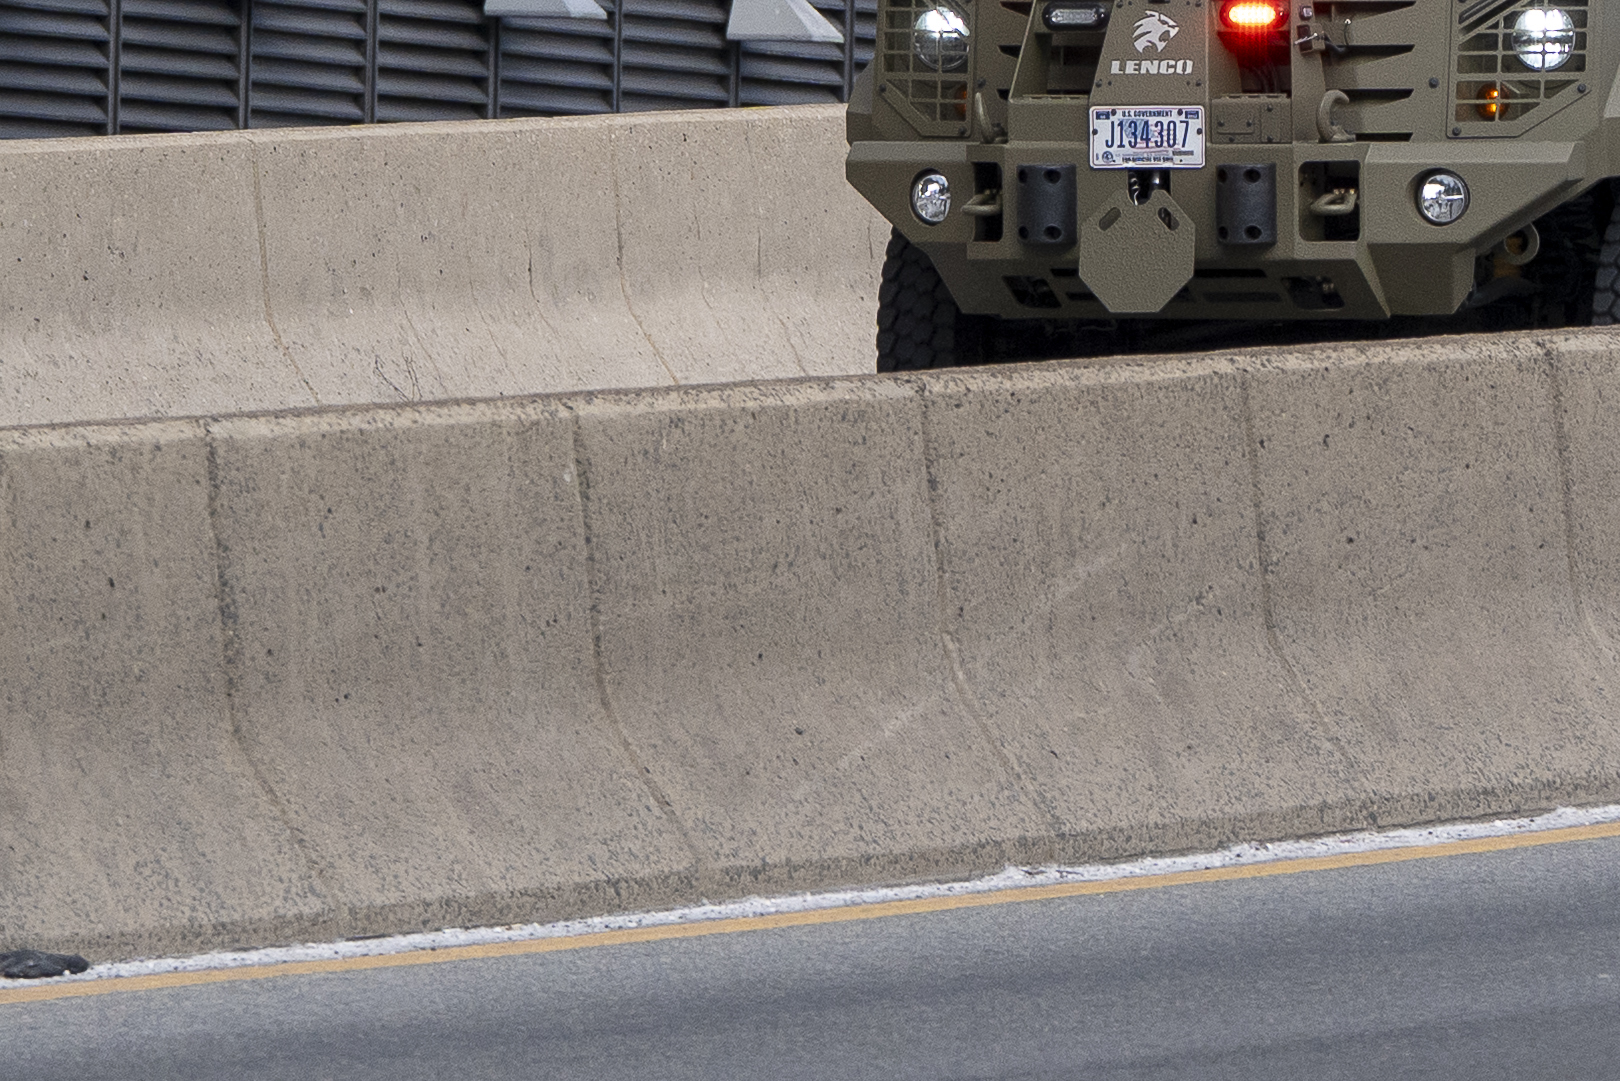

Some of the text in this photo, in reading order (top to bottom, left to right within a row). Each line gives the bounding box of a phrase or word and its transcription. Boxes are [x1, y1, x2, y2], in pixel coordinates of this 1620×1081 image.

[1111, 60, 1193, 75] LENCO
[1133, 110, 1172, 118] GOVERNMENT
[1105, 120, 1189, 149] J134307
